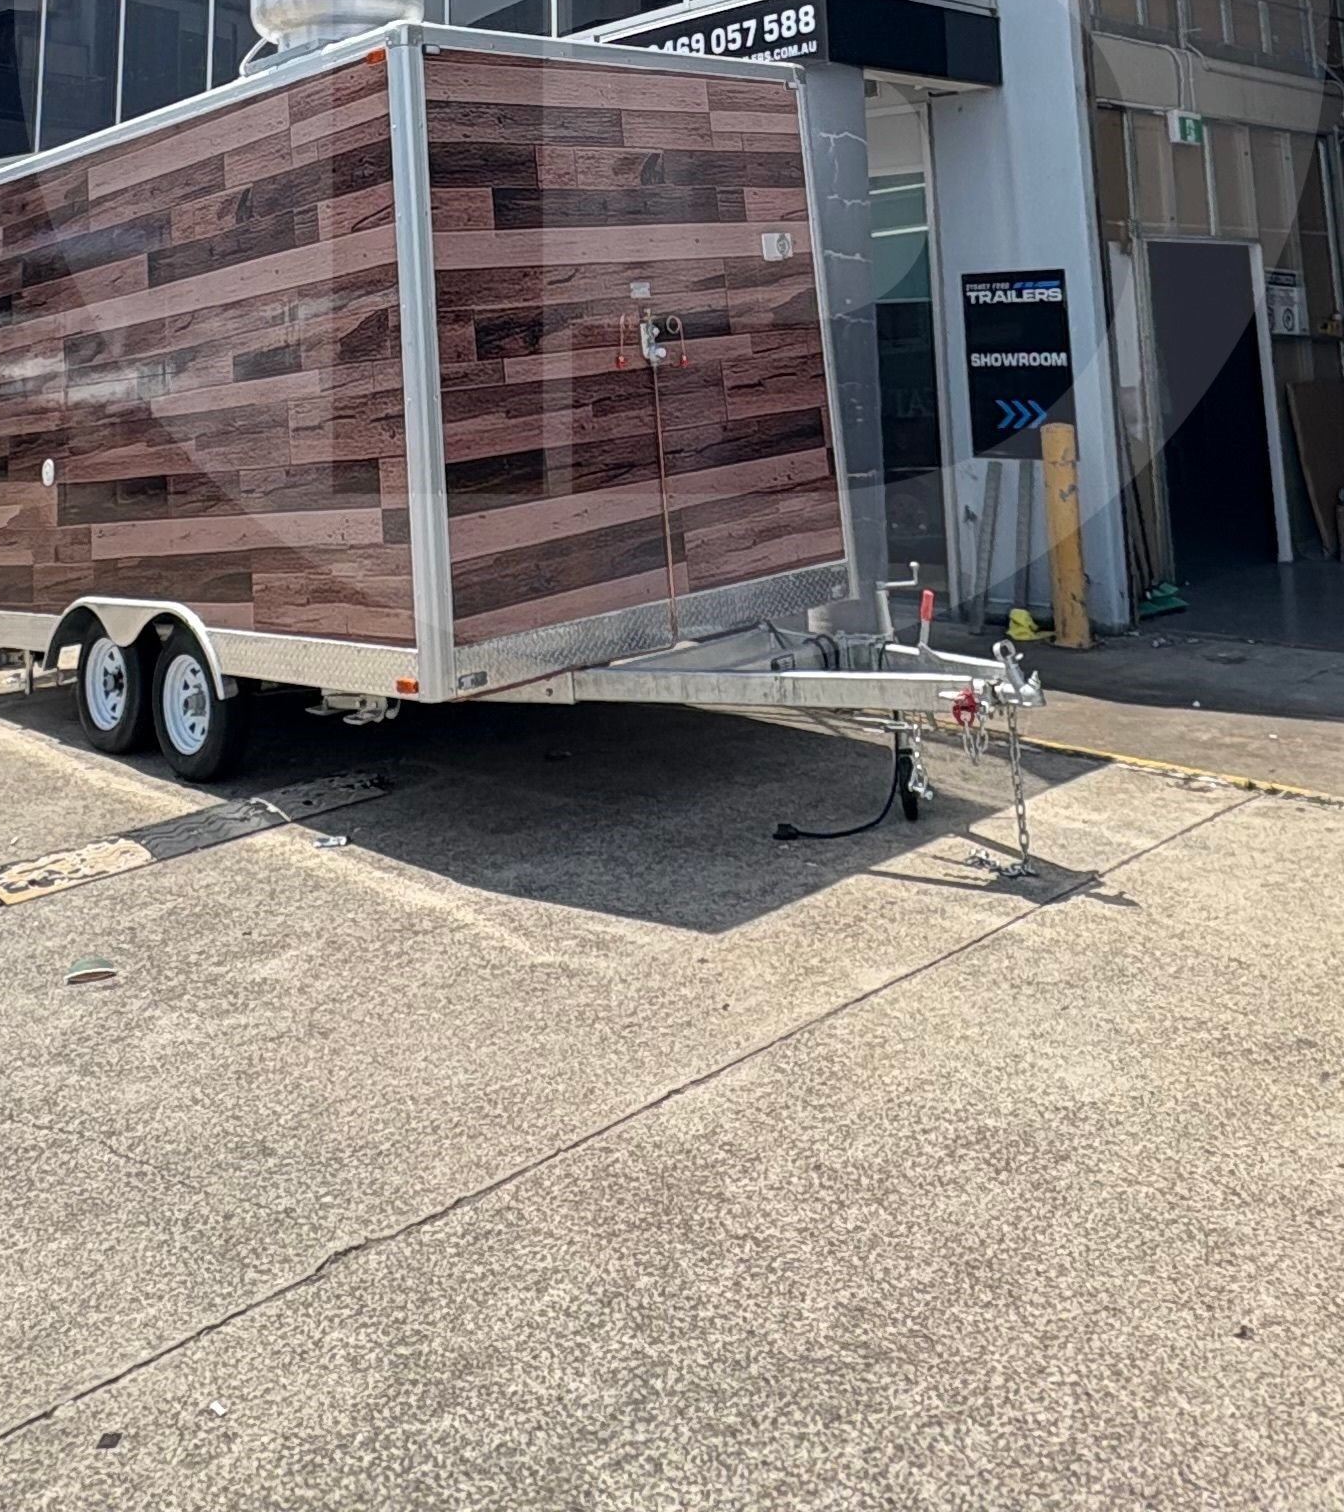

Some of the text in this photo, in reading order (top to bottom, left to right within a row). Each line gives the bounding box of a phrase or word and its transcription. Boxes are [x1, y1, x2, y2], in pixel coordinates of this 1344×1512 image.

[648, 4, 816, 55] 69 057 588
[966, 288, 1063, 304] TRAILERS
[970, 352, 1068, 367] SHOWROOM
